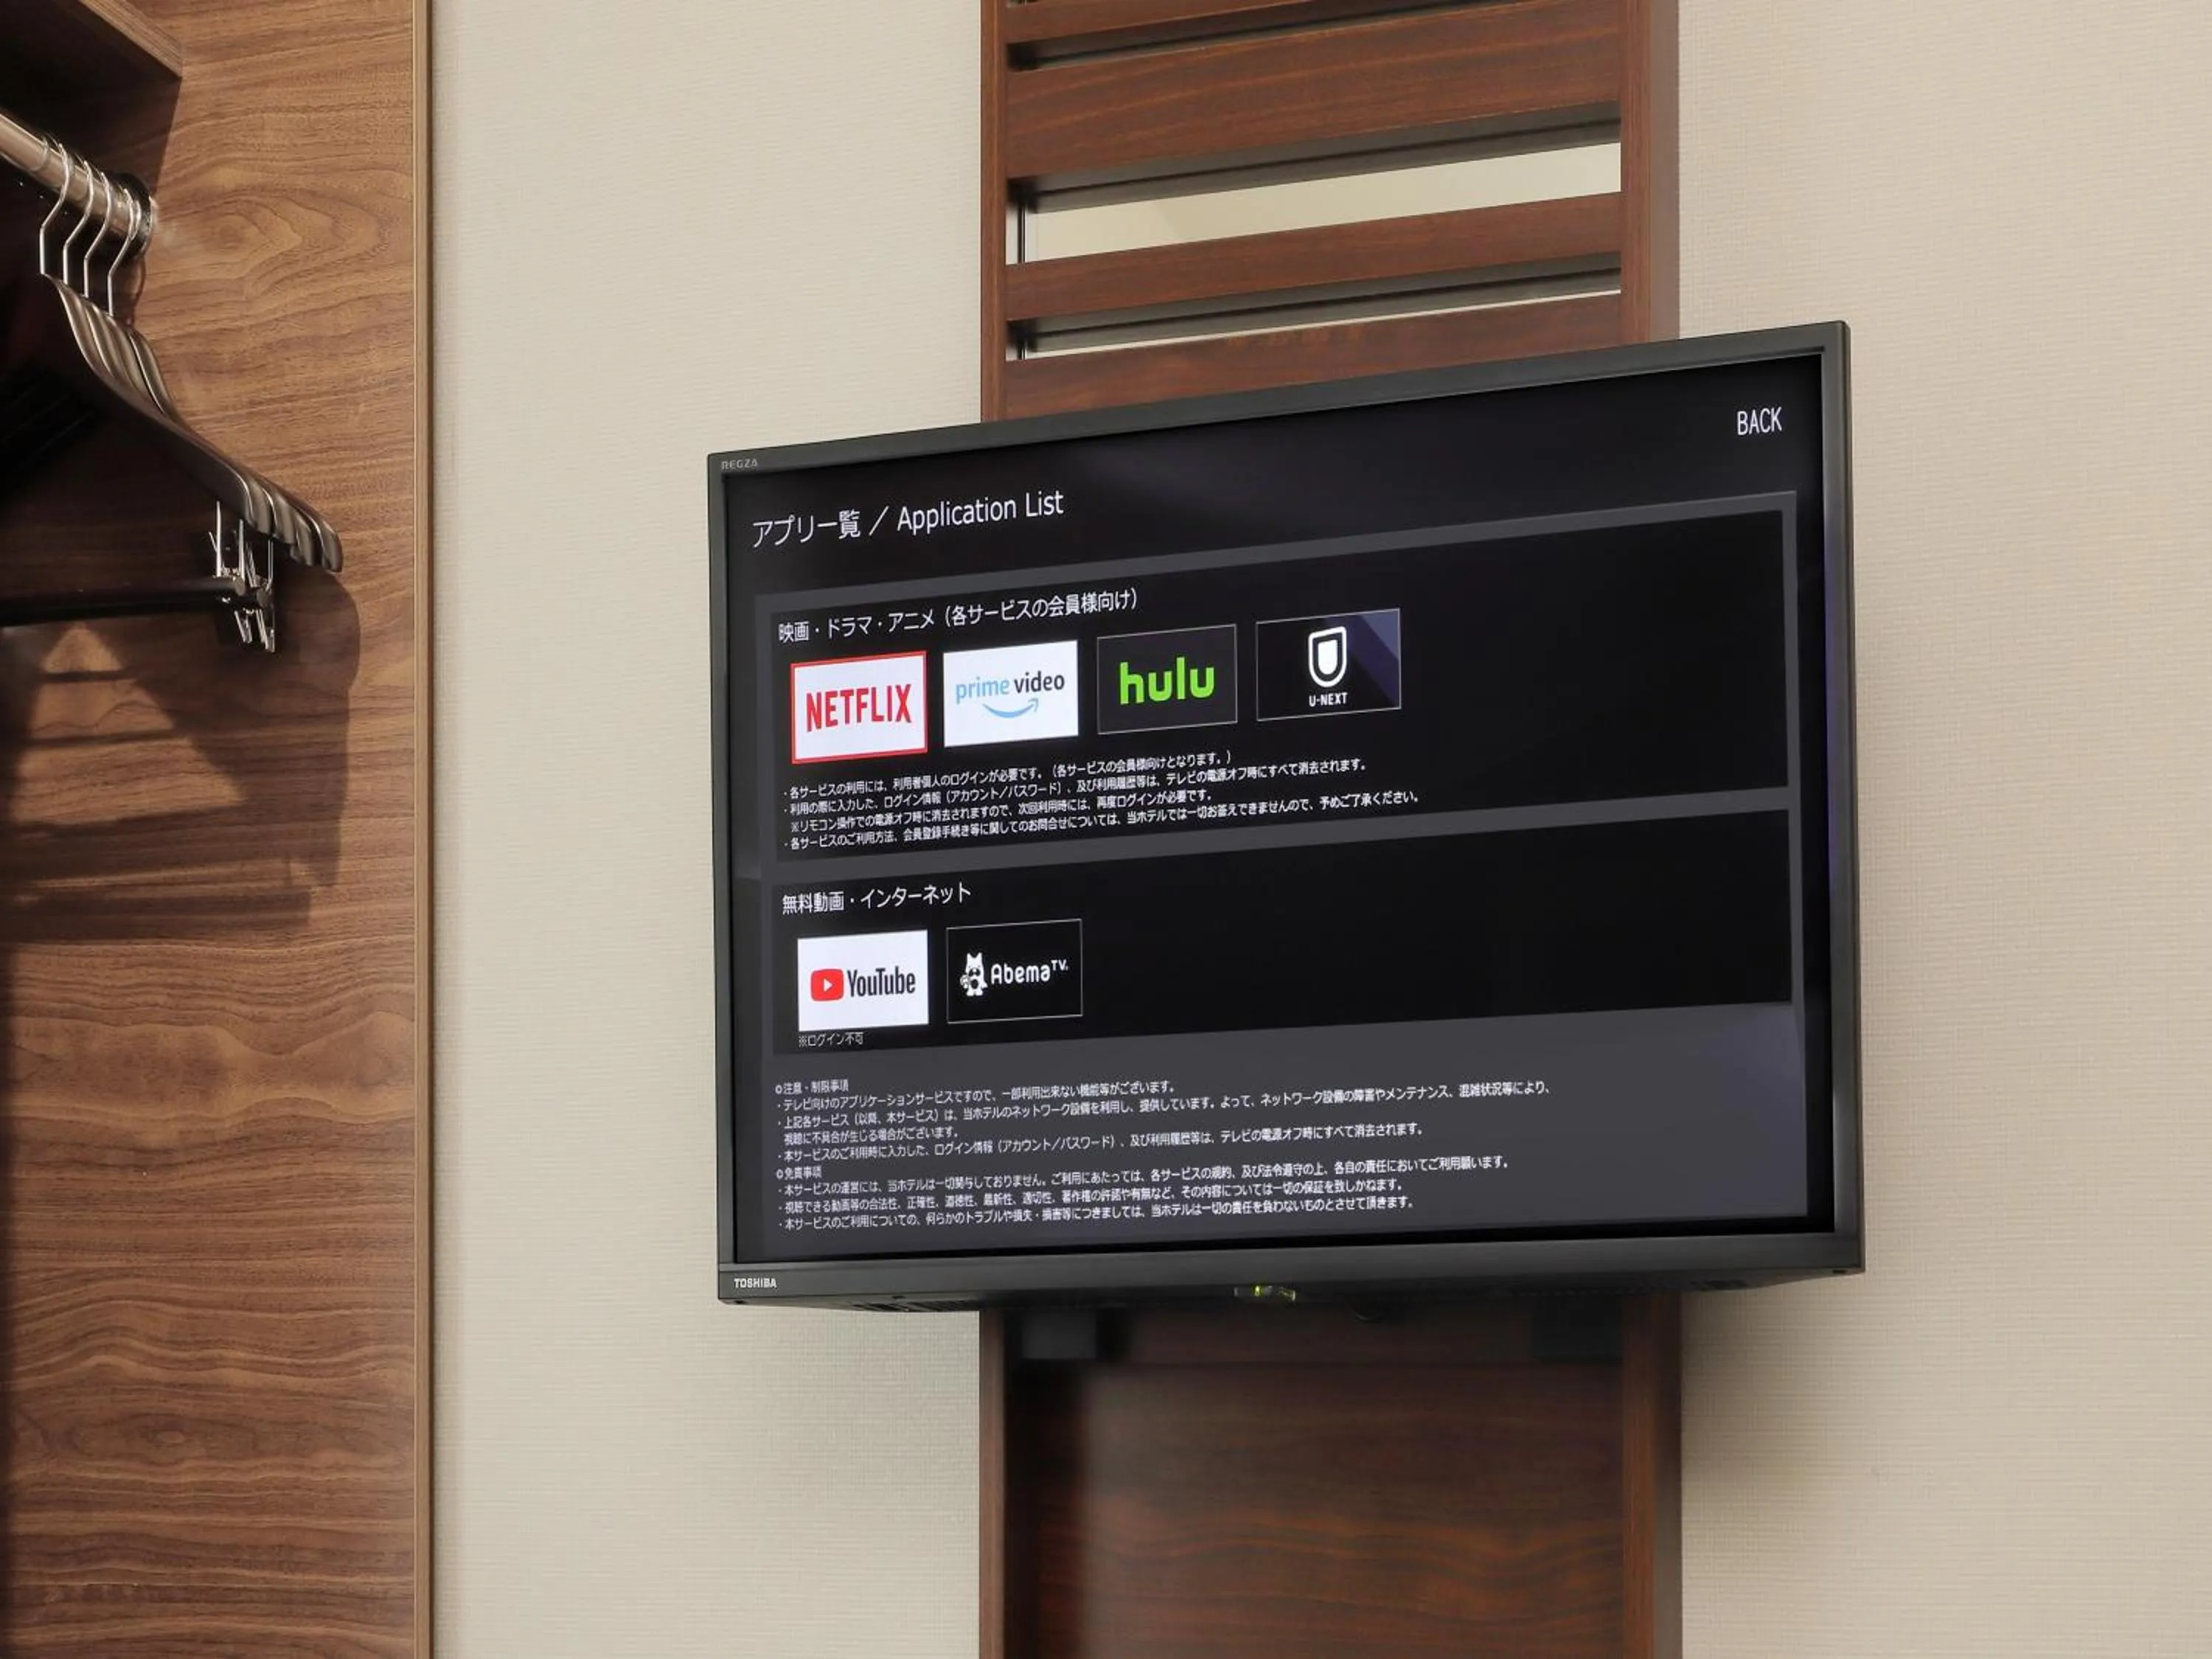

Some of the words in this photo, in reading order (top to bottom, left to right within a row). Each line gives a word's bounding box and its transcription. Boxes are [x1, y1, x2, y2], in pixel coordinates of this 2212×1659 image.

[1737, 406, 1782, 436] BACK
[721, 458, 758, 470] REGZA
[752, 509, 860, 548] アプリ一覧
[897, 496, 1017, 536] Application
[1026, 490, 1064, 518] List
[956, 676, 1009, 704] prime
[1015, 670, 1065, 694] video
[1120, 657, 1214, 706] hulu
[806, 684, 912, 733] NETFLIX
[1310, 692, 1348, 708] U-NEXT
[782, 882, 971, 914] 無料動画・インターネット
[847, 967, 916, 997] YouTube
[734, 1278, 777, 1289] TOSHIBA
